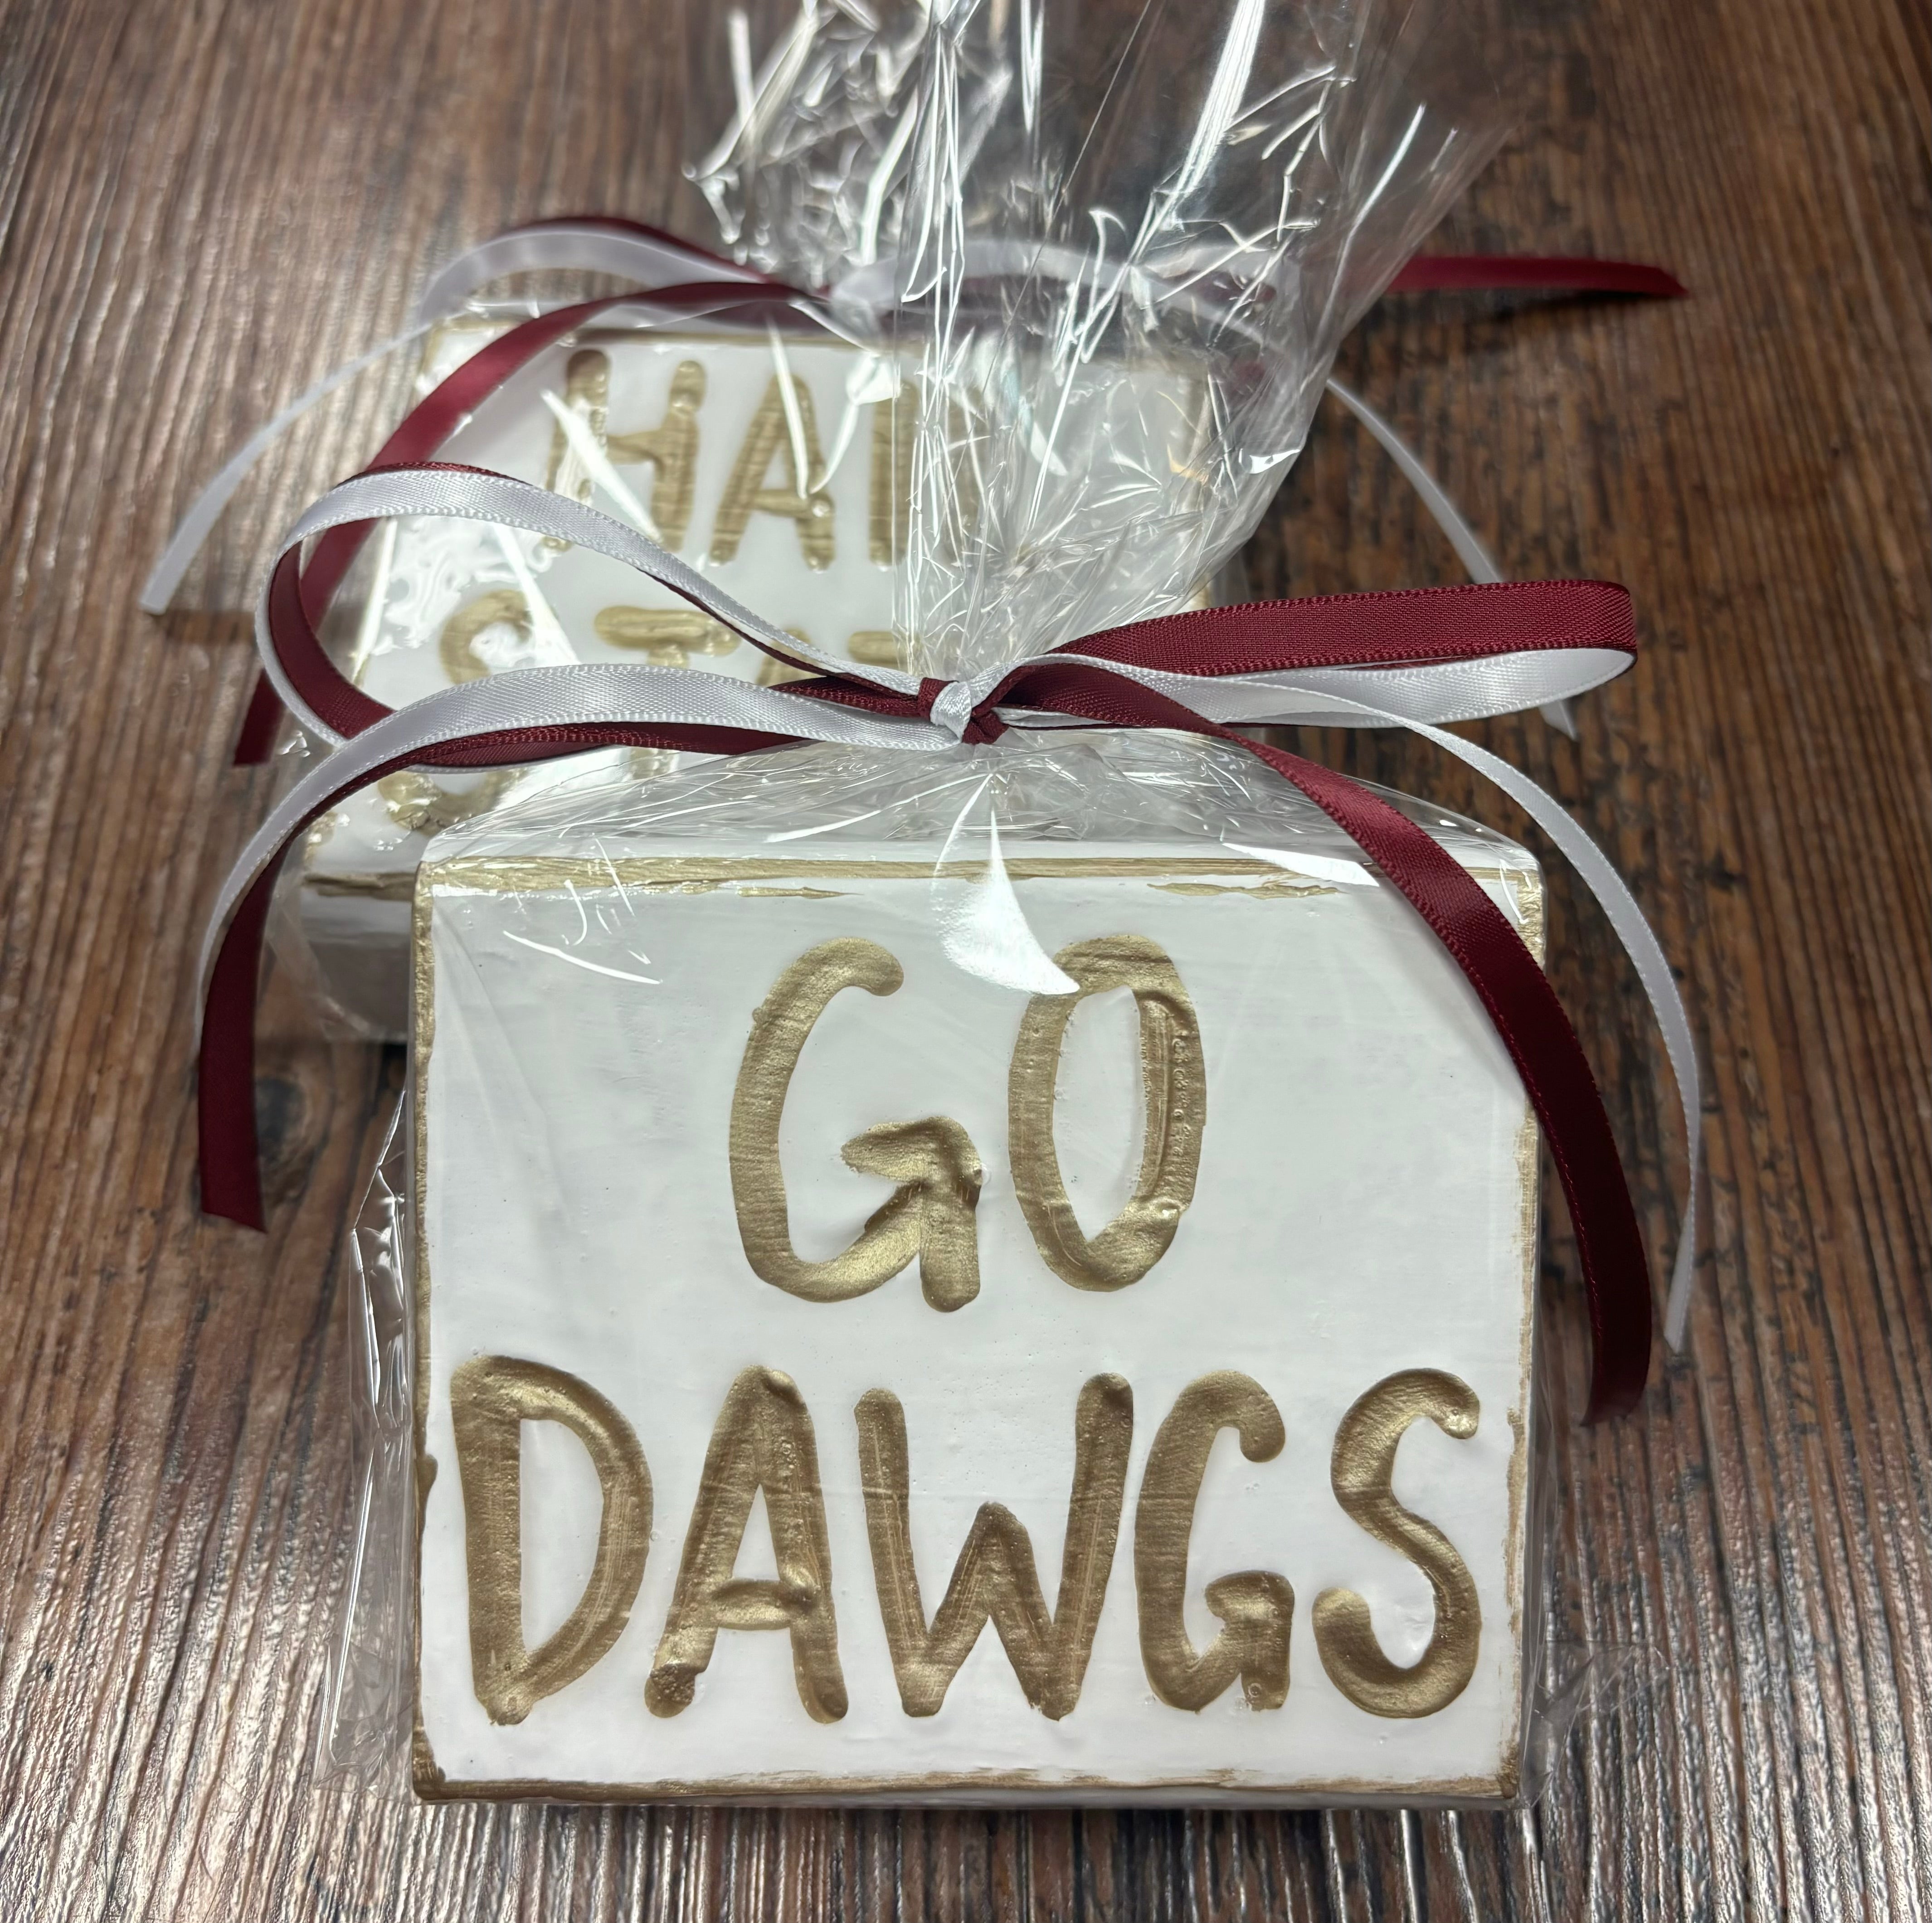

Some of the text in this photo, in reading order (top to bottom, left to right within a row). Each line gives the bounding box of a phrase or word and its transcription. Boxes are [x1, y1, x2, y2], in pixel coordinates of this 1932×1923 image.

[542, 348, 1002, 572] HAI
[728, 934, 1208, 1312] GO
[450, 1355, 1483, 1725] DAWGS
